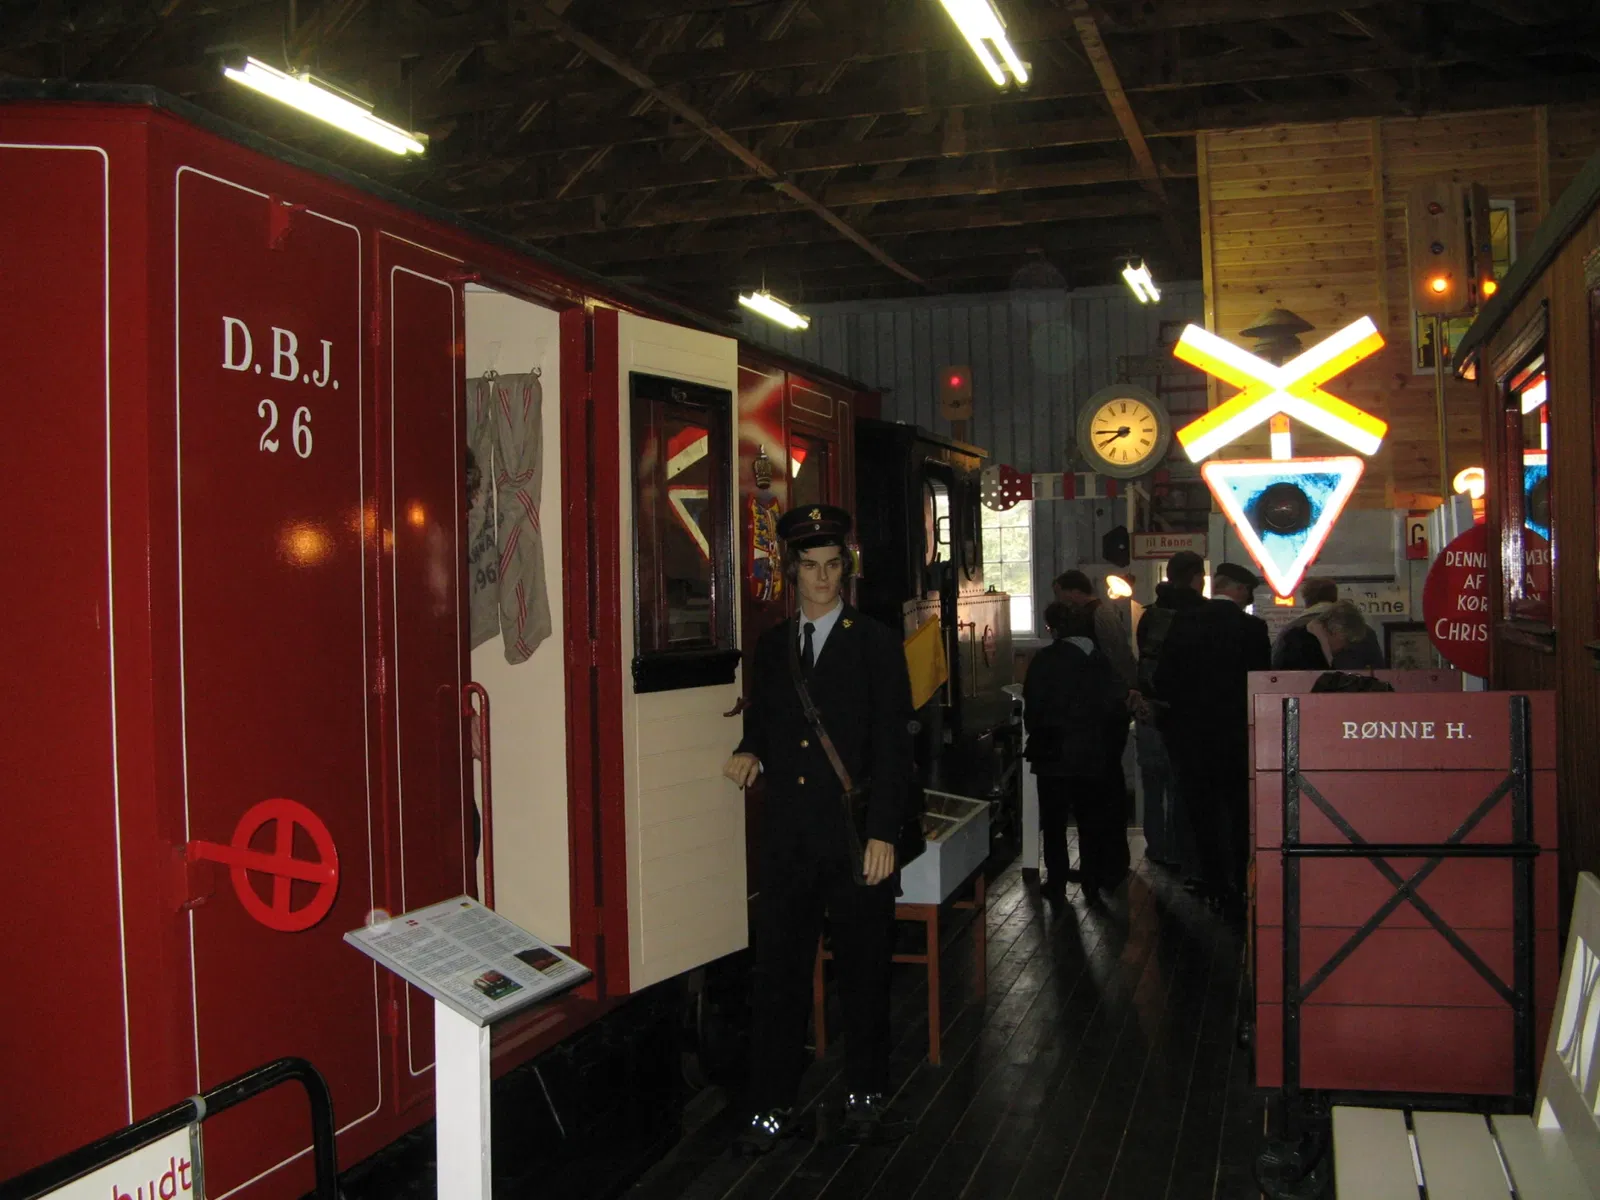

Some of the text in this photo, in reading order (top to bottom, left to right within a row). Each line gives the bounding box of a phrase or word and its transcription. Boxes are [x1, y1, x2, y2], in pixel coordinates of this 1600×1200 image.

[221, 315, 340, 391] D.B.J.
[257, 398, 313, 459] 26
[1411, 523, 1425, 547] G
[1463, 573, 1485, 590] AF
[1342, 721, 1473, 740] RØNNE H.
